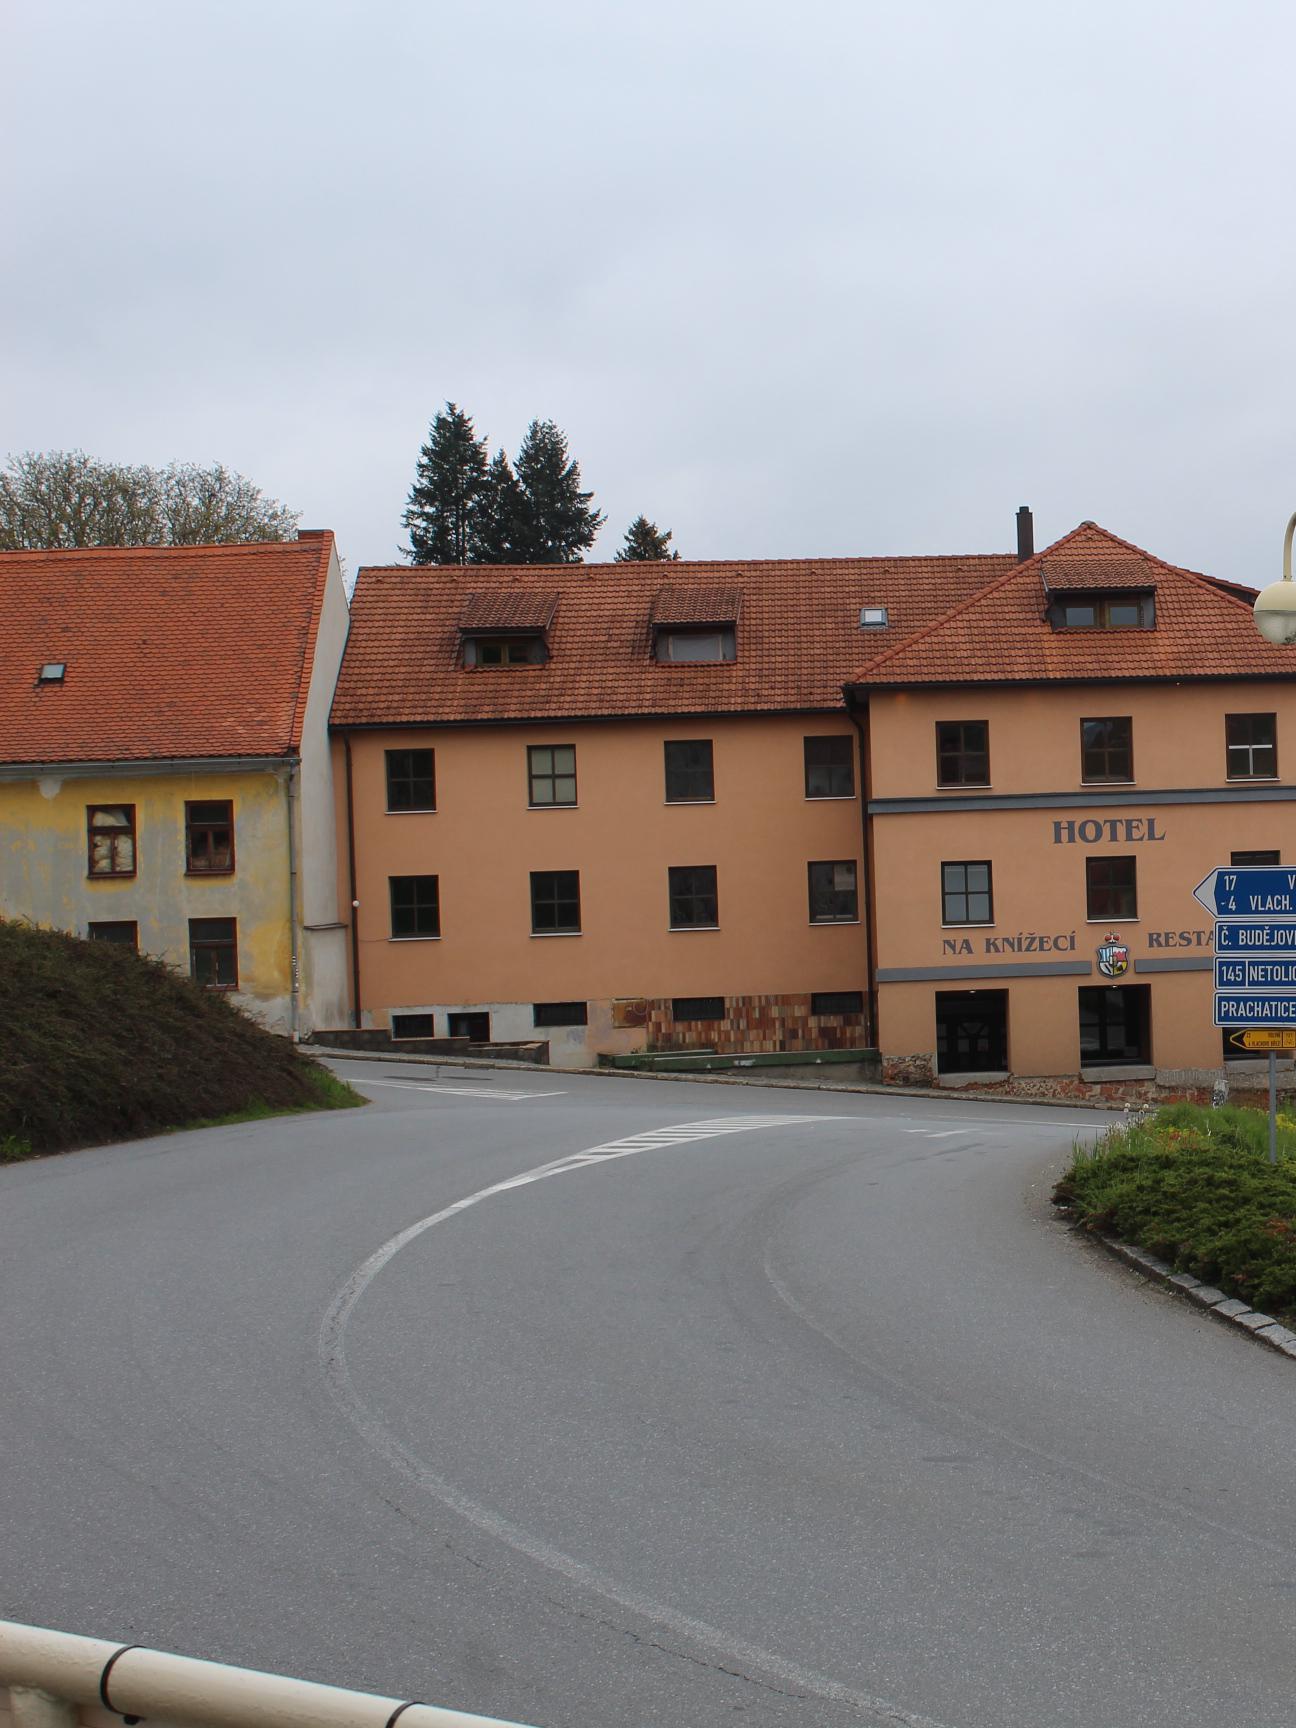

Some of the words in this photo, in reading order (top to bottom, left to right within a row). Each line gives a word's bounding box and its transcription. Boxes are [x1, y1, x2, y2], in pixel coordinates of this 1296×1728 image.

[1052, 818, 1166, 844] HOTEL
[1224, 875, 1237, 891] 17
[1228, 895, 1236, 911] 4
[1250, 895, 1293, 910] VLACH.
[942, 938, 974, 955] NA
[984, 930, 1076, 954] KNÍŽECÍ
[1148, 930, 1214, 948] RESTA
[1221, 926, 1232, 946] Č.
[1221, 966, 1243, 982] 145
[1221, 1001, 1296, 1017] PRACHATICE
